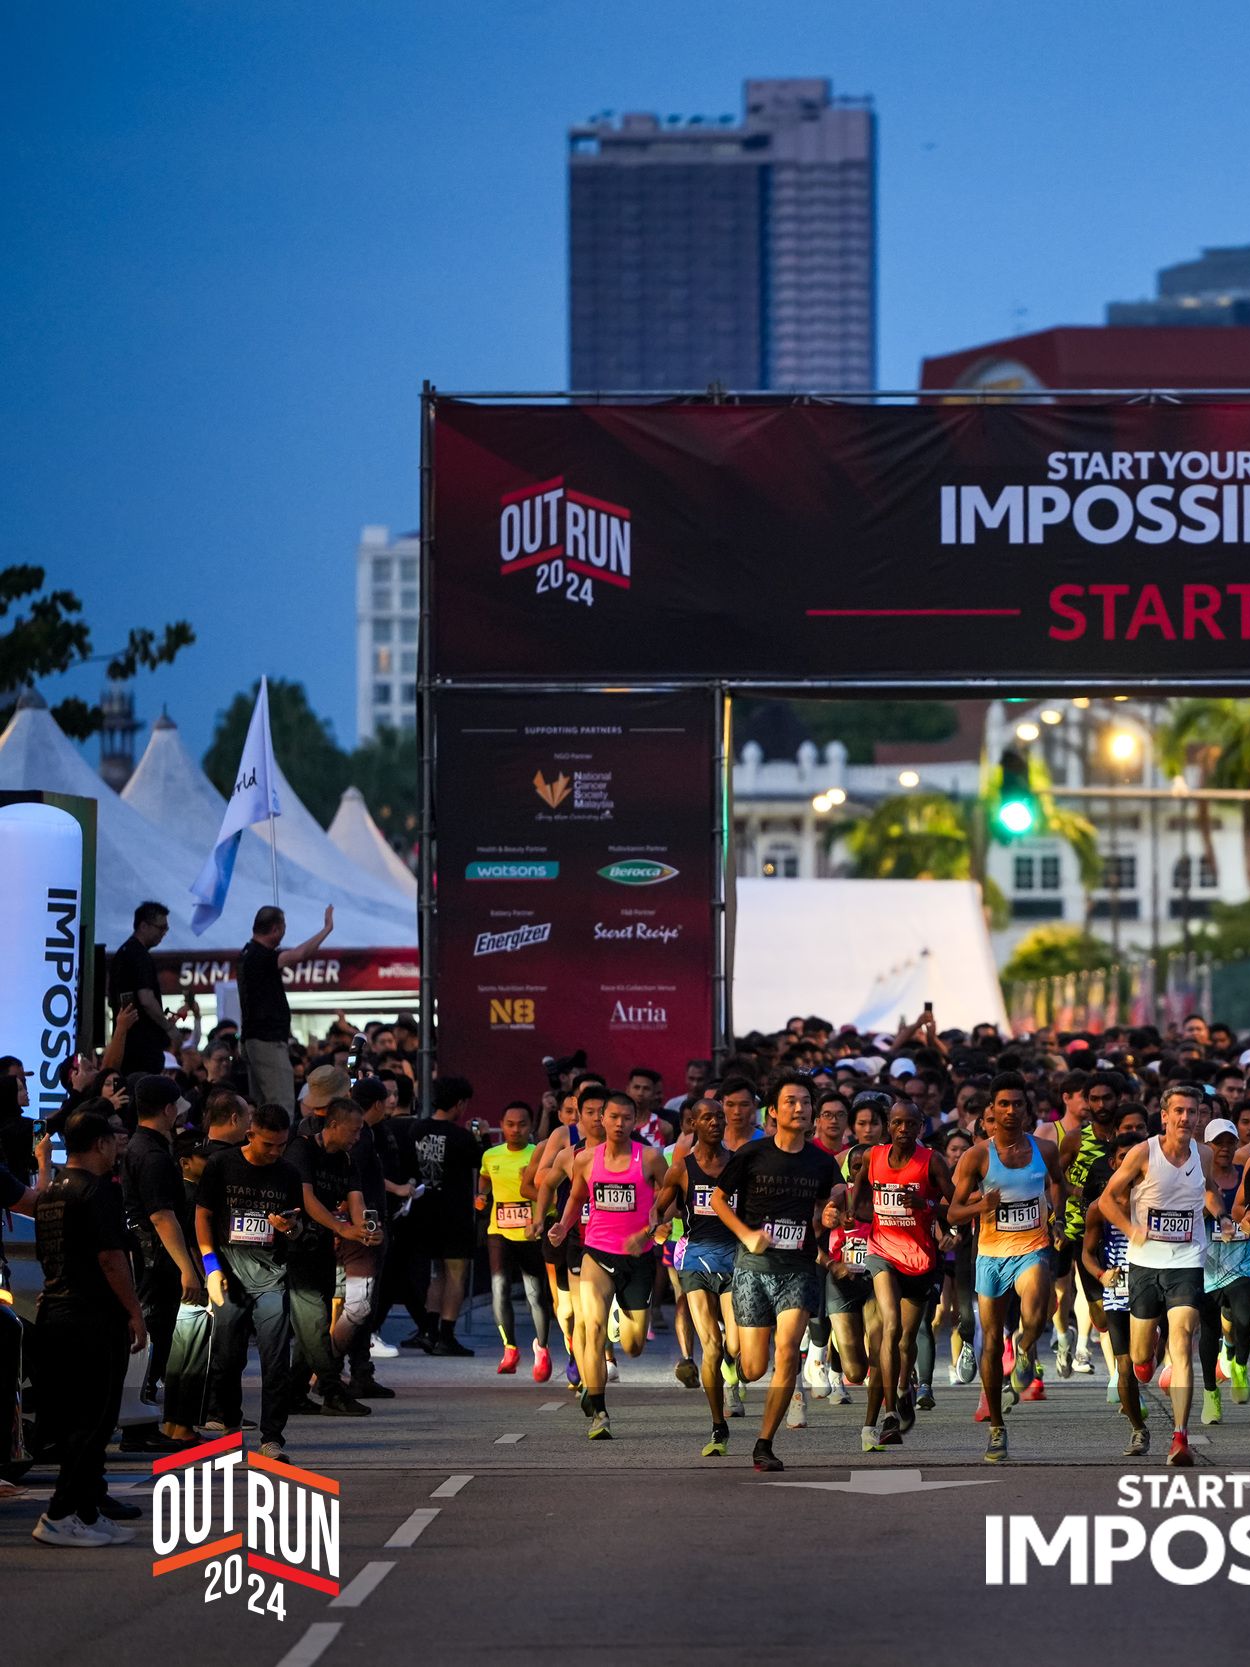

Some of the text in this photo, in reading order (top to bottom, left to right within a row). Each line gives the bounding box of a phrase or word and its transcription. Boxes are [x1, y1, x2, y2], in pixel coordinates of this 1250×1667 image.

[1046, 451, 1155, 480] START
[535, 558, 594, 607] 2024
[525, 726, 622, 735] SUPPORTING PARTNERS
[574, 771, 612, 781] National
[477, 865, 547, 877] watsons
[608, 866, 662, 878] Berocca
[475, 924, 550, 954] Energizer
[594, 921, 679, 944] Secret Recipe
[179, 960, 231, 986] 5KM
[281, 959, 341, 985] SHER
[489, 998, 536, 1024] N8
[610, 1000, 667, 1023] Atria
[415, 1140, 446, 1153] NORTH
[429, 1134, 446, 1144] THE
[423, 1152, 445, 1162] FACE
[225, 1184, 257, 1197] START
[595, 1189, 632, 1203] C 1376
[874, 1191, 881, 1205] A
[696, 1192, 703, 1207] E
[506, 1208, 529, 1219] 4142
[999, 1206, 1037, 1222] C 1510
[233, 1217, 242, 1232] E
[879, 1219, 917, 1227] MARATHON
[1151, 1216, 1190, 1232] E 2920
[775, 1225, 804, 1240] 4073
